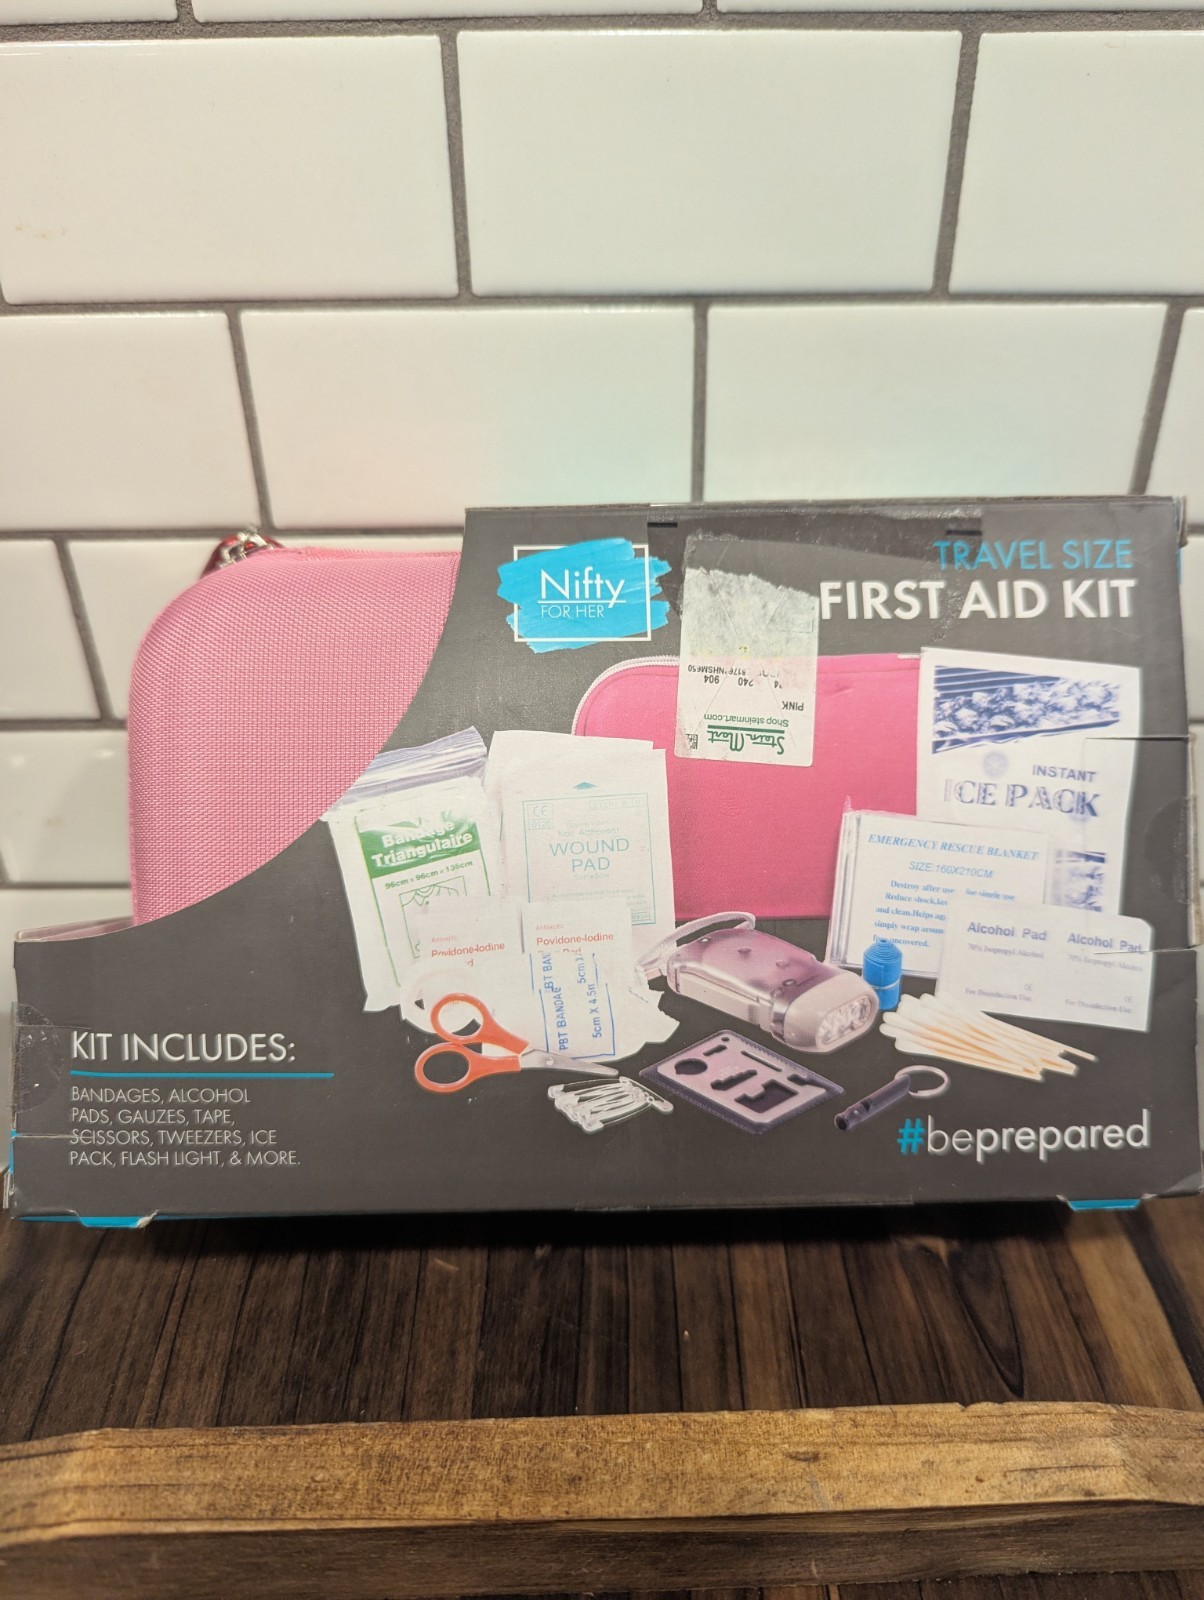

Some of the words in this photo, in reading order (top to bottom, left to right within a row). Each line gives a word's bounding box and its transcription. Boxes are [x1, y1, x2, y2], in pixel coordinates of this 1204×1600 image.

[933, 540, 1052, 570] TRAVEL
[1062, 539, 1134, 569] SIZE
[541, 567, 625, 608] Nifty
[819, 580, 946, 620] FIRST
[959, 579, 1048, 619] AID
[1062, 578, 1136, 619] KIT
[541, 605, 571, 618] FOR
[576, 605, 604, 618] HER
[704, 675, 720, 684] 904
[781, 701, 804, 711] PINK
[704, 713, 765, 725] steinmart.com
[766, 717, 789, 727] Shop
[707, 730, 744, 752] Mart
[746, 733, 785, 755] Stein
[1032, 765, 1096, 783] INSTANT
[943, 779, 998, 806] ICE
[1005, 784, 1100, 817] PACK
[371, 830, 474, 868] Triangulaire
[549, 838, 630, 857] WOUND
[868, 834, 938, 850] EMERGENCY
[940, 841, 984, 856] RESCUE
[987, 847, 1039, 861] BLANKET
[572, 857, 611, 872] PAD
[890, 880, 919, 891] Destroy
[922, 884, 941, 893] after
[885, 892, 912, 903] Reduce
[875, 906, 890, 914] and
[874, 920, 898, 930] simply
[900, 924, 919, 933] wrap
[967, 921, 1015, 937] Alcohol
[1022, 928, 1047, 941] Pad
[536, 932, 614, 946] Povidone-Iodine
[1067, 932, 1113, 949] Alcohol
[431, 942, 505, 958] Povidone-Iodine
[592, 1017, 602, 1038] 5cm
[71, 1030, 113, 1061] KIT
[122, 1032, 296, 1062] INCLUDES:
[558, 1032, 569, 1050] PBT
[71, 1086, 164, 1104] BANDAGES,
[169, 1088, 251, 1103] ALCOHOL
[71, 1107, 113, 1126] PADS,
[118, 1109, 190, 1126] GAUZES,
[193, 1109, 235, 1126] TAPE,
[70, 1128, 153, 1147] SCISSORS,
[158, 1129, 246, 1147] TWEEZERS,
[251, 1129, 277, 1145] ICE
[897, 1108, 1150, 1163] #beprepared
[69, 1150, 116, 1168] PACK,
[121, 1150, 169, 1166] FLASH
[174, 1150, 225, 1168] LIGHT,
[230, 1151, 242, 1166] &
[247, 1150, 301, 1166] MORE.
